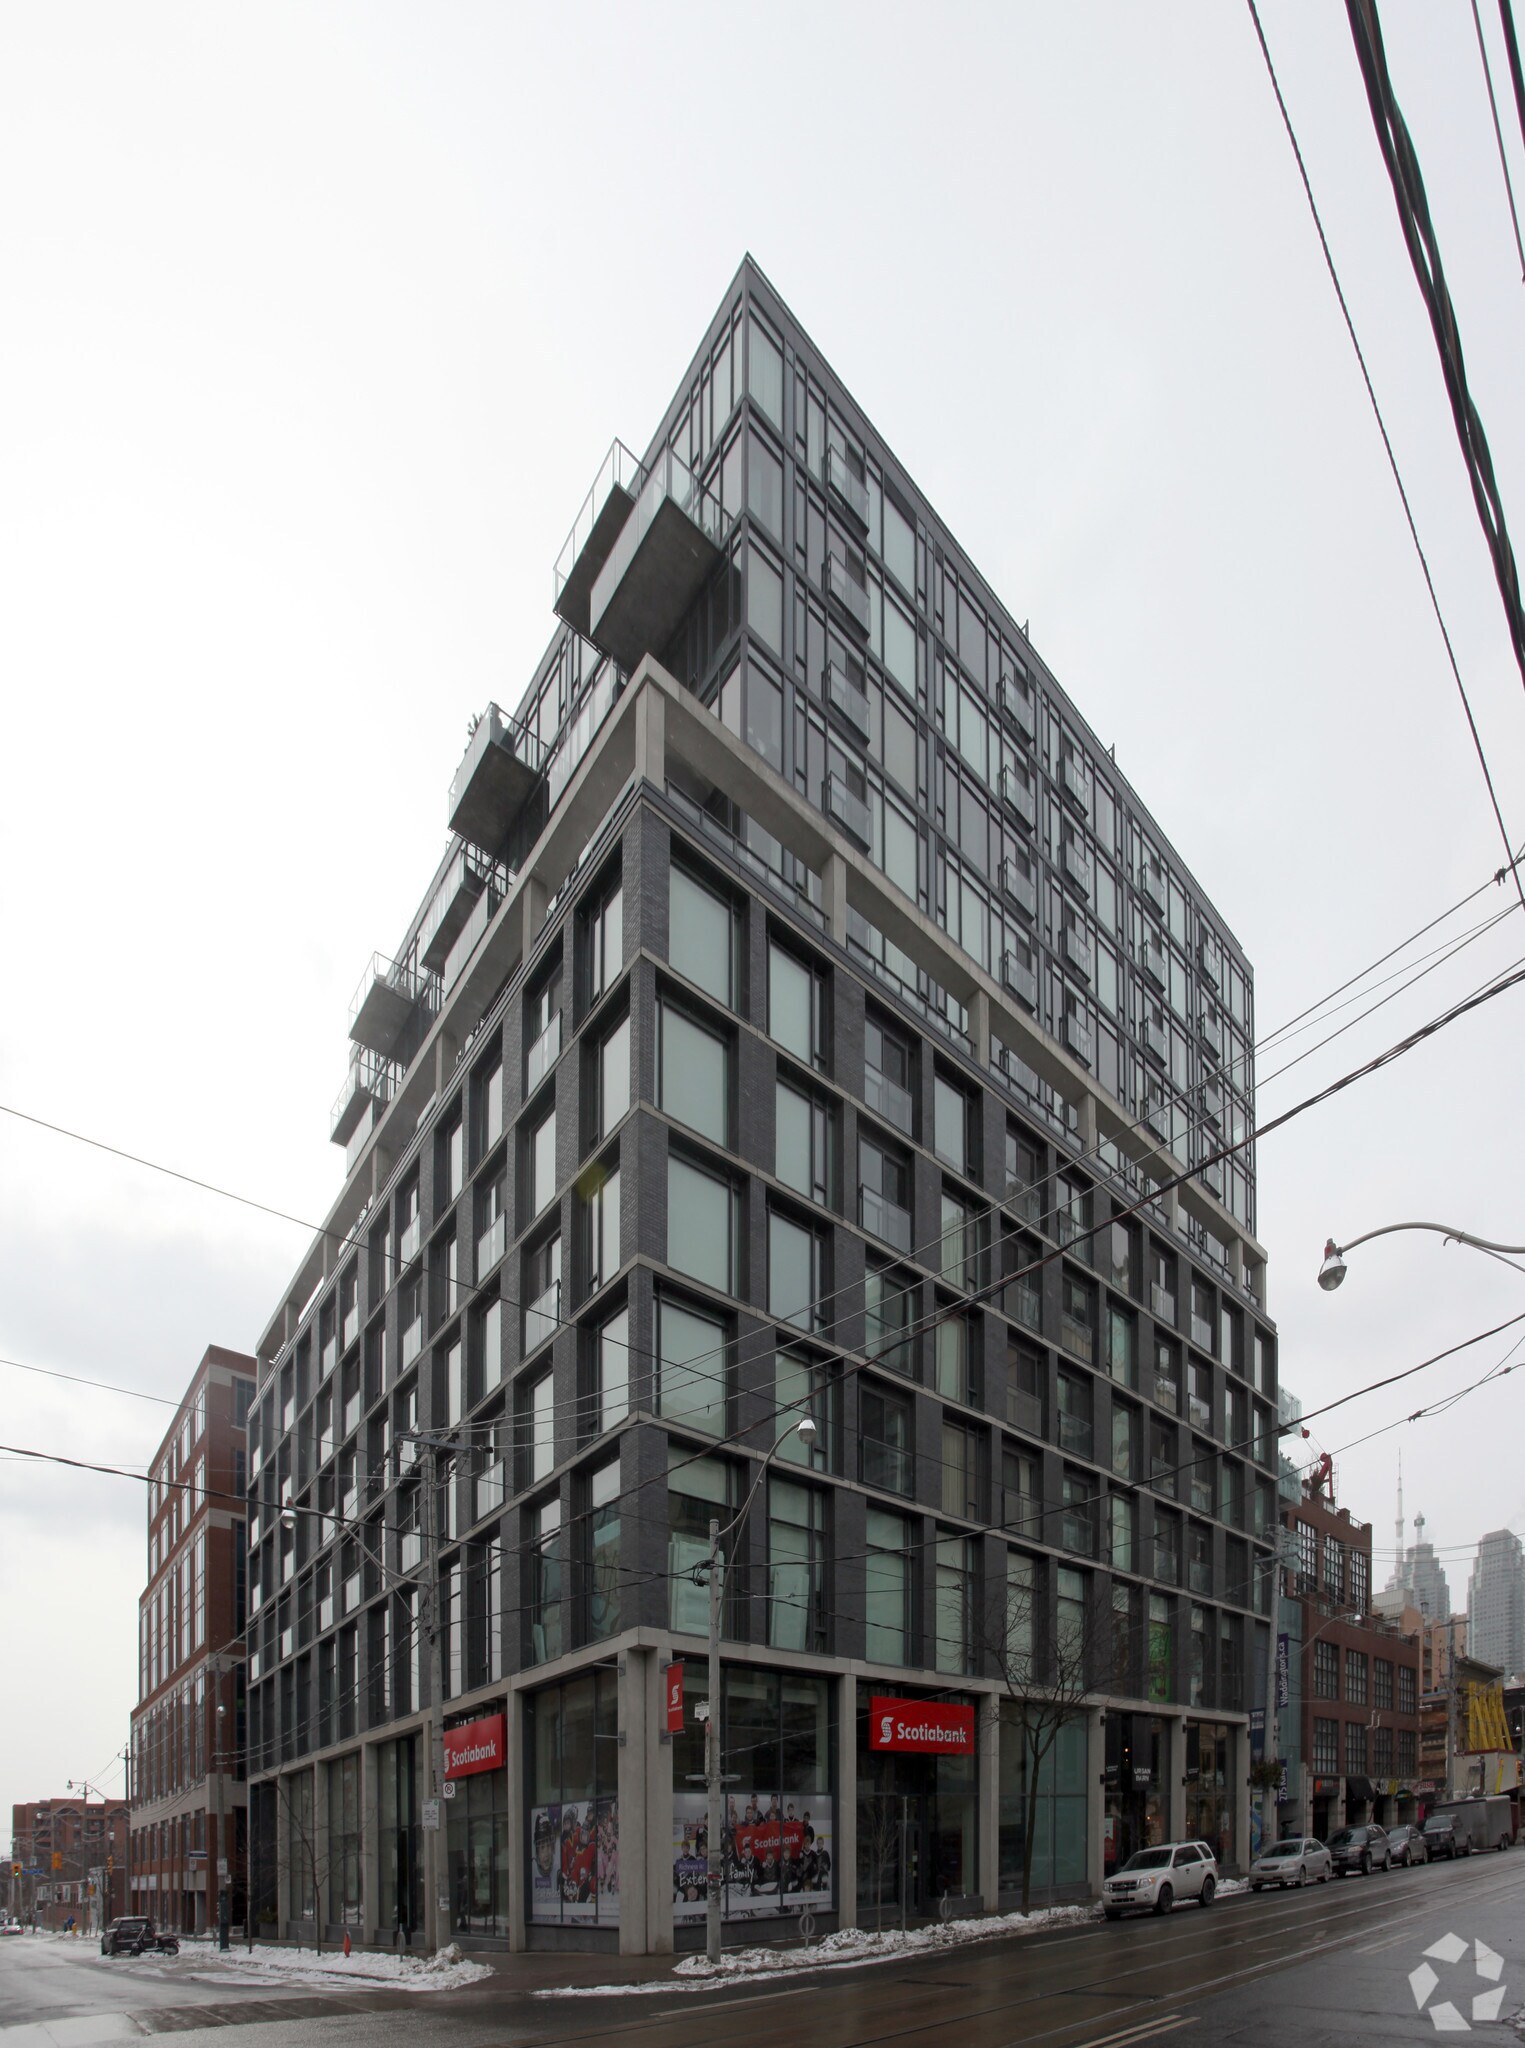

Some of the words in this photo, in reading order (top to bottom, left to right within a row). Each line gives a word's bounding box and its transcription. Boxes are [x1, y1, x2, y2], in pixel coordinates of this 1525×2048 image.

[897, 1722, 967, 1743] Scotiabank
[451, 1739, 496, 1767] Scotiabank
[1133, 1767, 1151, 1775] URBAN
[1279, 1787, 1288, 1802] 275
[729, 1862, 755, 1883] family
